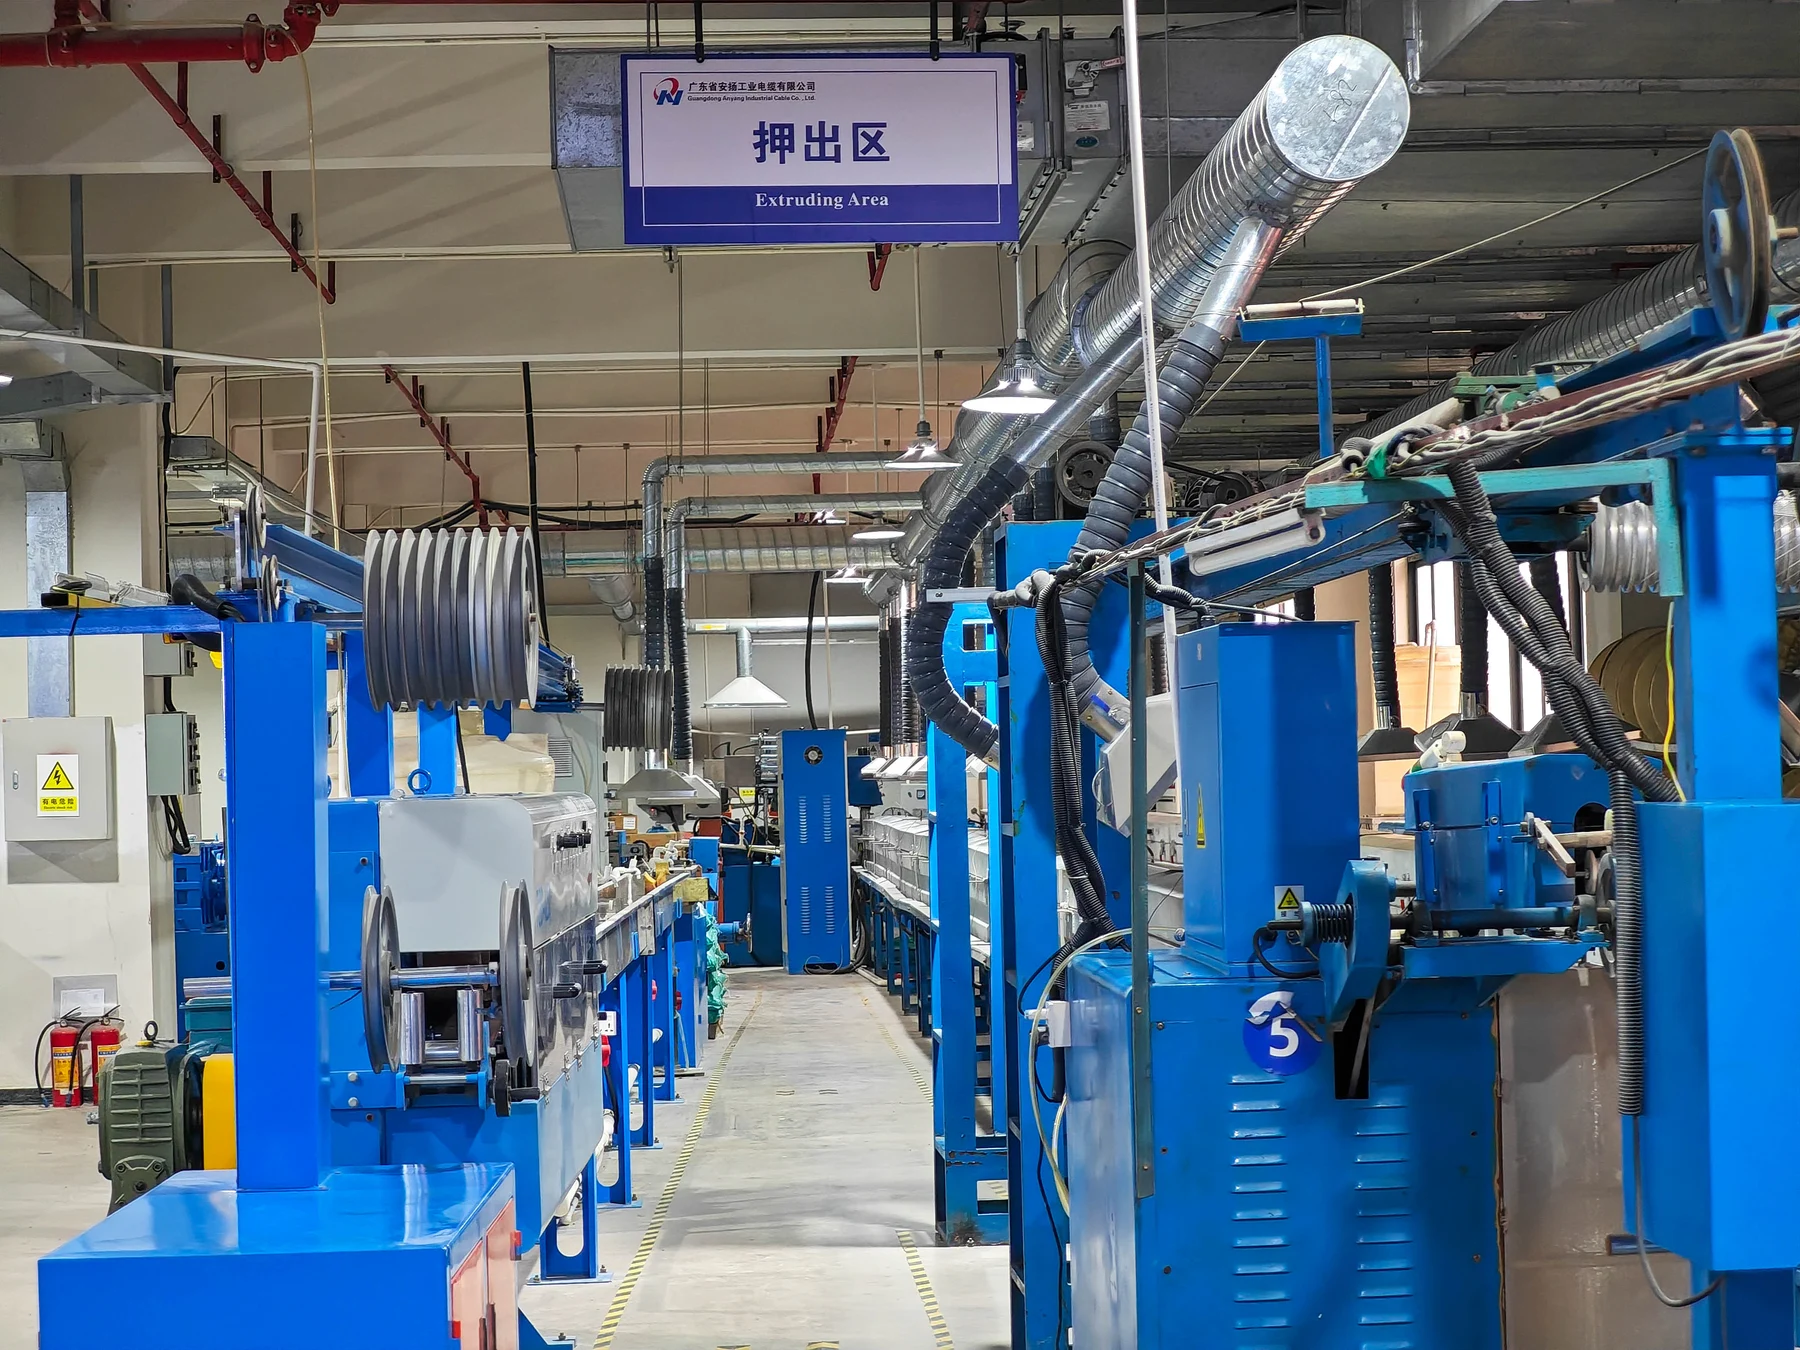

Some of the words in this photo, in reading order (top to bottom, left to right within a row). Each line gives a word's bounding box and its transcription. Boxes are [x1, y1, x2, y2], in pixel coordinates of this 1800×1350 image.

[688, 81, 816, 92] 广东省安扬工业电缆有限公司
[752, 120, 890, 164] 押出区
[755, 193, 844, 210] Extruding
[847, 192, 889, 206] Area
[1269, 1015, 1299, 1057] 5
